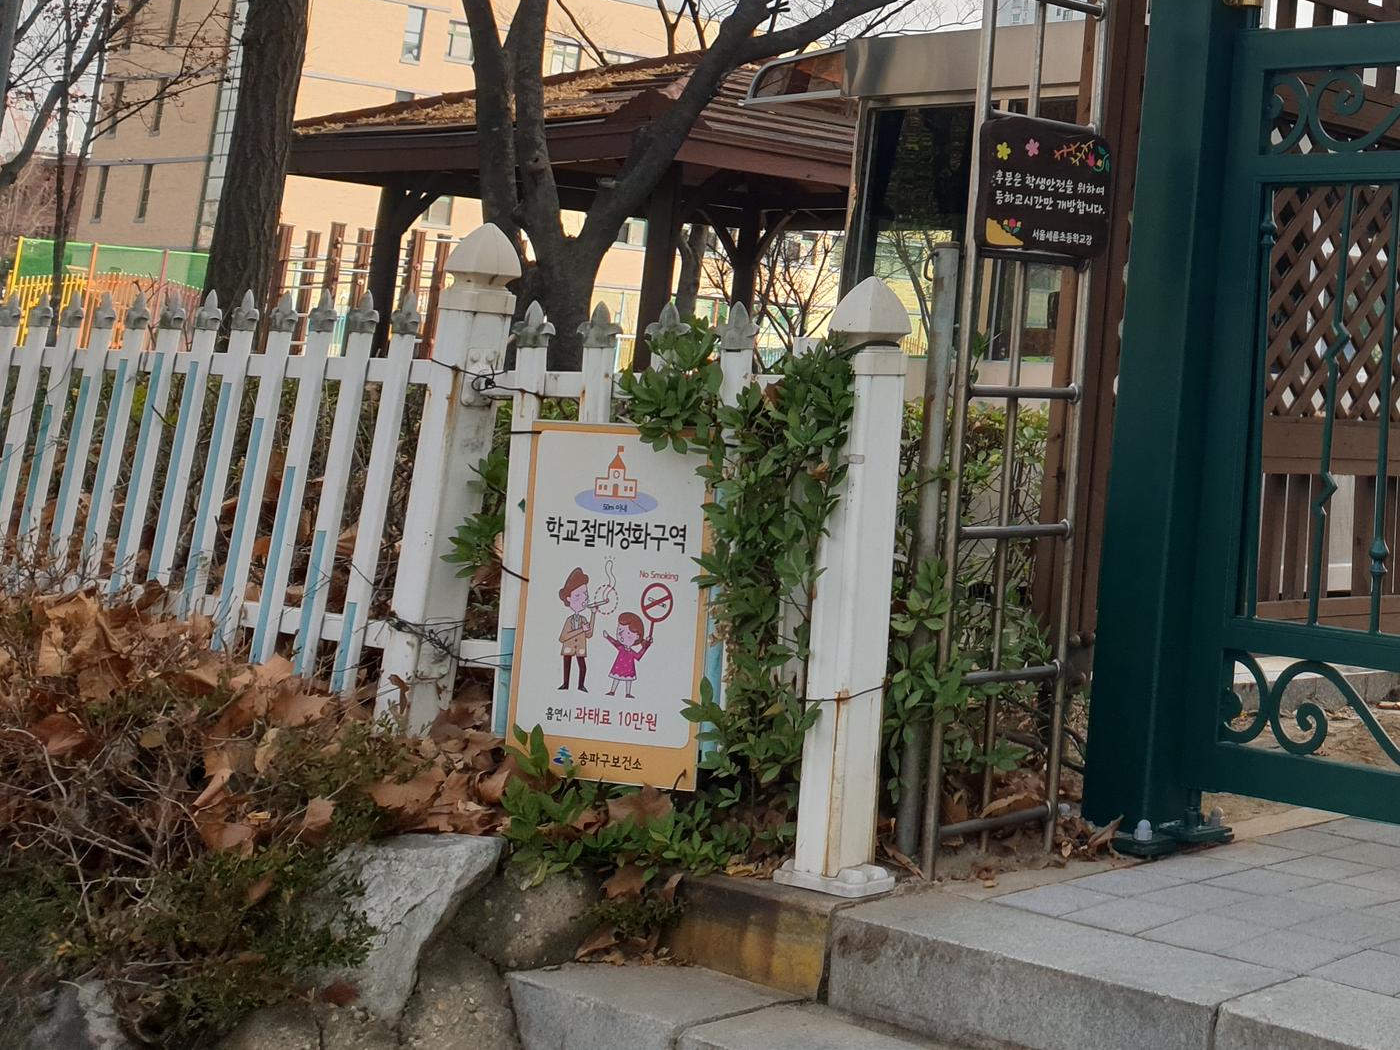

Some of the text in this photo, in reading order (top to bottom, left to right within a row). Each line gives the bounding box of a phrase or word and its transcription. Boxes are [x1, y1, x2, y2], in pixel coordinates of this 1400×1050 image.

[995, 169, 1105, 196] 후문은 학생안전을 위하여
[995, 190, 1106, 215] 등하교시간만 개방합니다.
[1032, 229, 1093, 246] 서울세륜초등학교장
[546, 516, 687, 554] 학교절대정화구역
[640, 570, 679, 582] No Smoking
[546, 706, 658, 732] 흡연시 과태료 10만원
[578, 751, 643, 771] 송파구보건소
